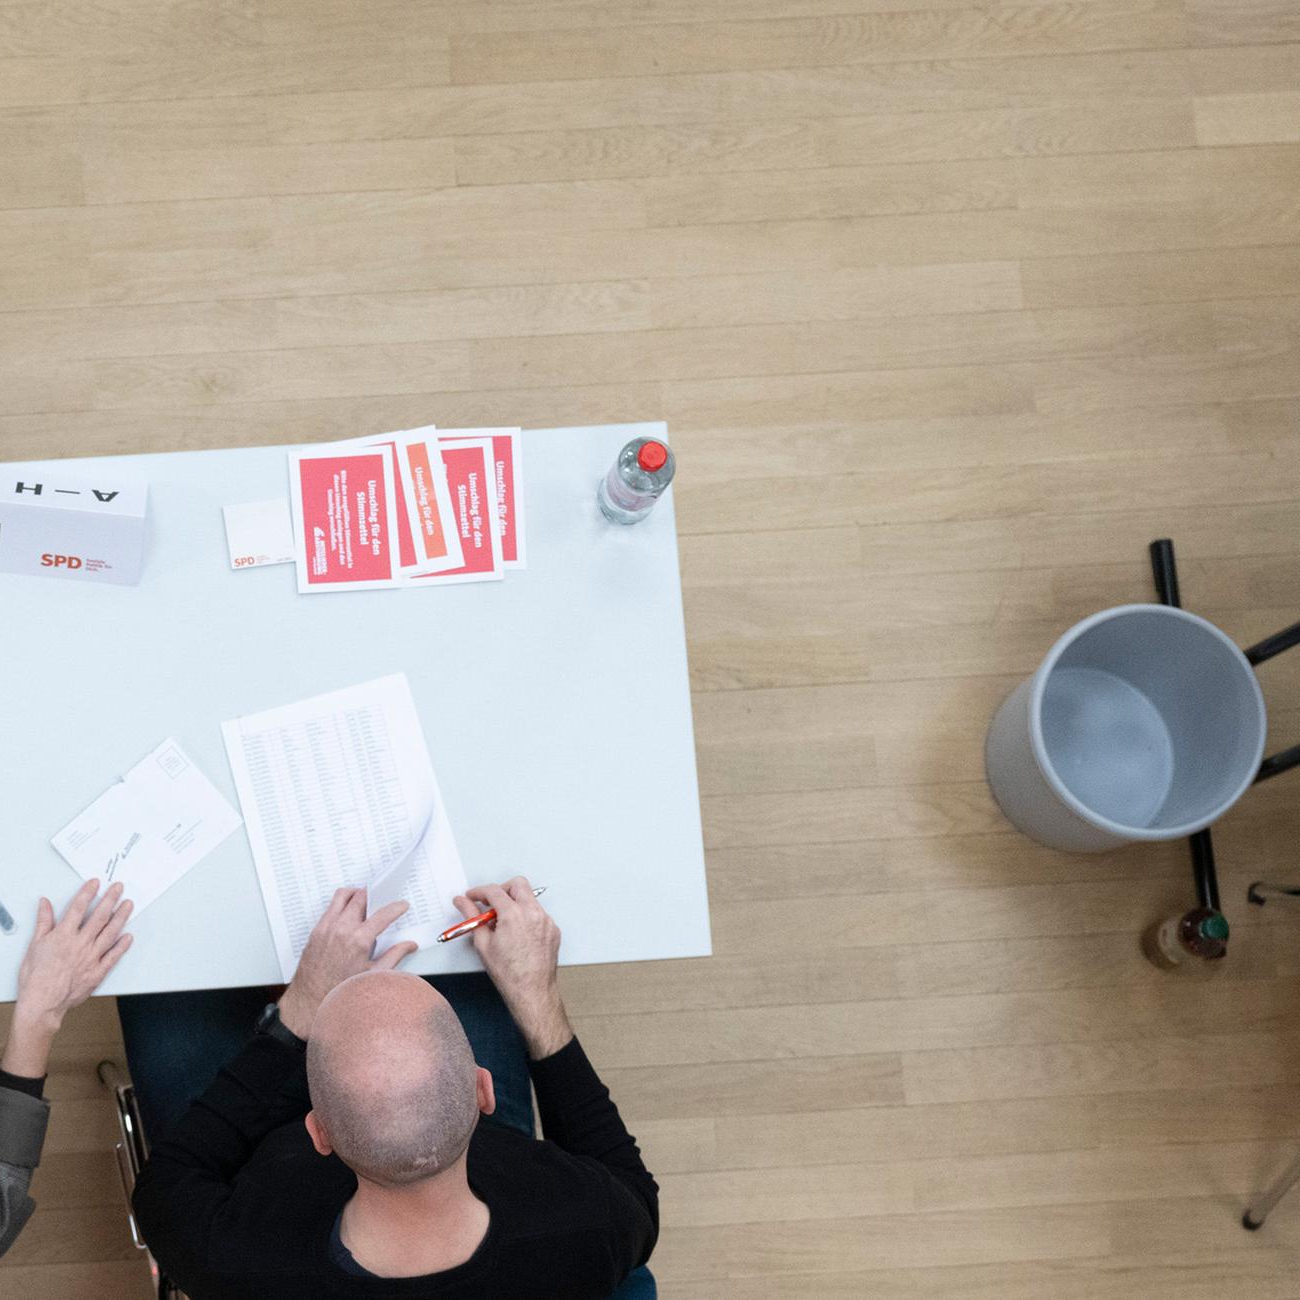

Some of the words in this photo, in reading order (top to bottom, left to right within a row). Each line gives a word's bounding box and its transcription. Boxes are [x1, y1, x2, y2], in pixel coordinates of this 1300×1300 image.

[15, 482, 43, 496] H
[415, 467, 429, 506] Umschlag
[496, 461, 506, 503] Umschlag
[92, 489, 119, 502] A
[366, 480, 379, 523] Umschlag
[467, 472, 481, 516] Umschlag
[356, 491, 369, 545] Stimmzettel
[423, 506, 432, 520] für
[457, 484, 471, 538] Stimmzettel
[498, 504, 507, 517] für
[371, 523, 380, 537] für
[425, 520, 435, 535] den
[473, 516, 482, 529] für
[372, 538, 382, 555] den
[474, 531, 484, 548] den
[40, 554, 82, 570] SPD
[234, 554, 256, 568] SPD
